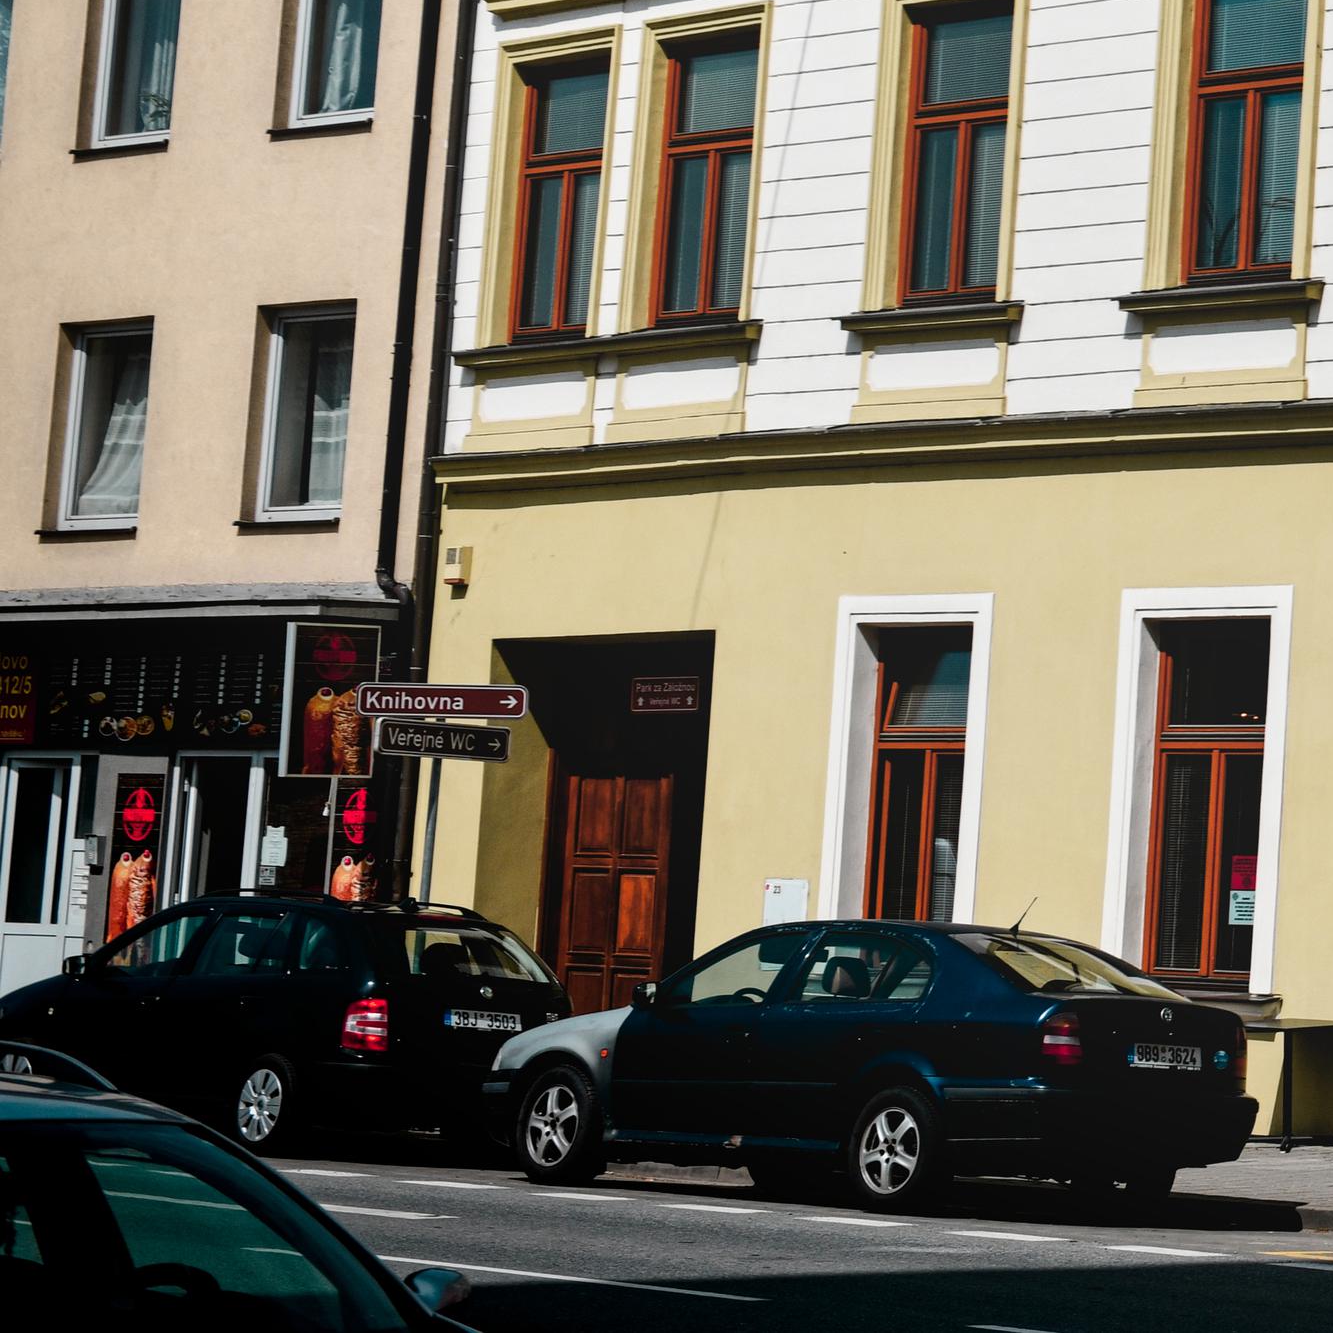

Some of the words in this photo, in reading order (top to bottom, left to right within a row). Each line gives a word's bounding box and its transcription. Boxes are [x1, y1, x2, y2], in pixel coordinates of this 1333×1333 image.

[0, 652, 29, 671] ovo
[635, 682, 652, 693] Park
[365, 690, 465, 711] Knihovna
[387, 729, 445, 750] Veřejné
[450, 733, 476, 752] WC
[454, 1011, 478, 1027] 3BJ
[487, 1013, 516, 1030] 3503
[1136, 1045, 1160, 1062] 9B9
[1168, 1046, 1197, 1065] 3624
